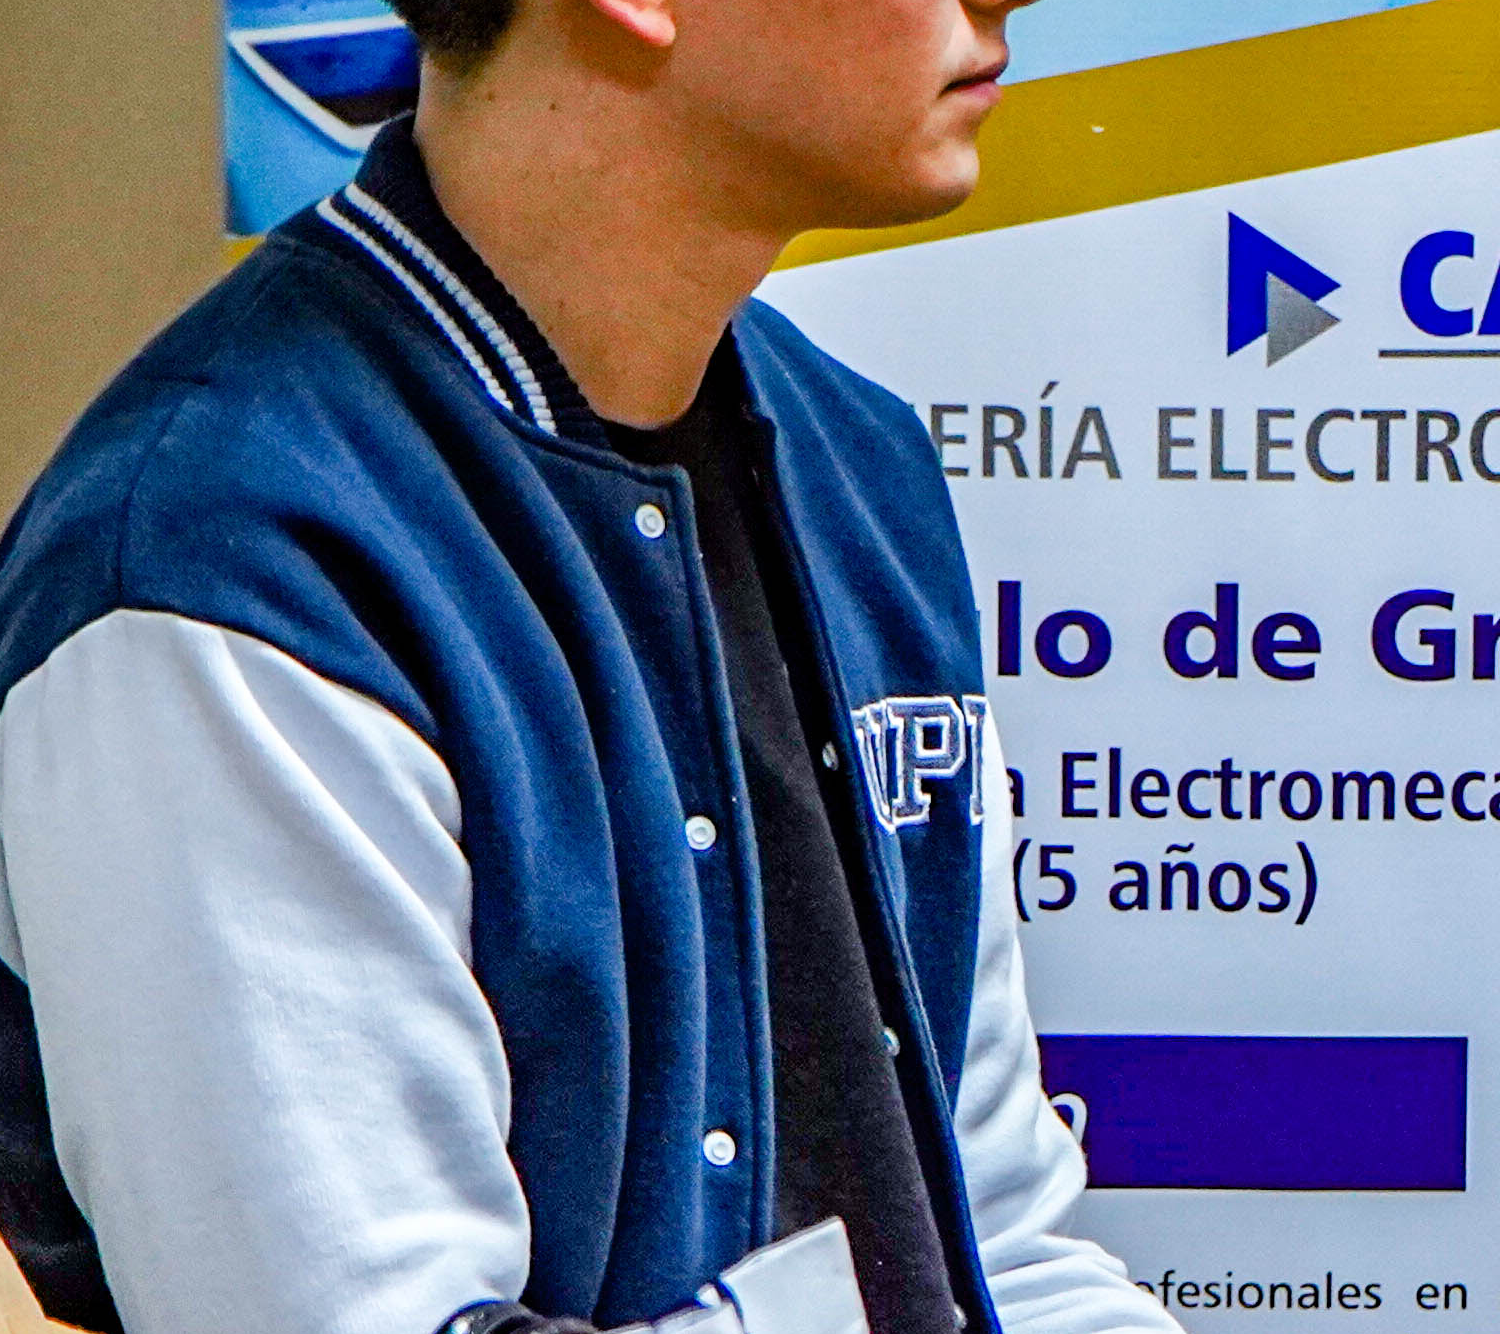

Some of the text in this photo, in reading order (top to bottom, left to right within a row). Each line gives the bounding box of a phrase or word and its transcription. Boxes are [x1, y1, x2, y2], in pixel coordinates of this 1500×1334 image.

[909, 380, 1123, 481] ERÍA
[1162, 582, 1322, 681] de
[1012, 838, 1319, 924] (5 años)
[1415, 1282, 1467, 1310] en
